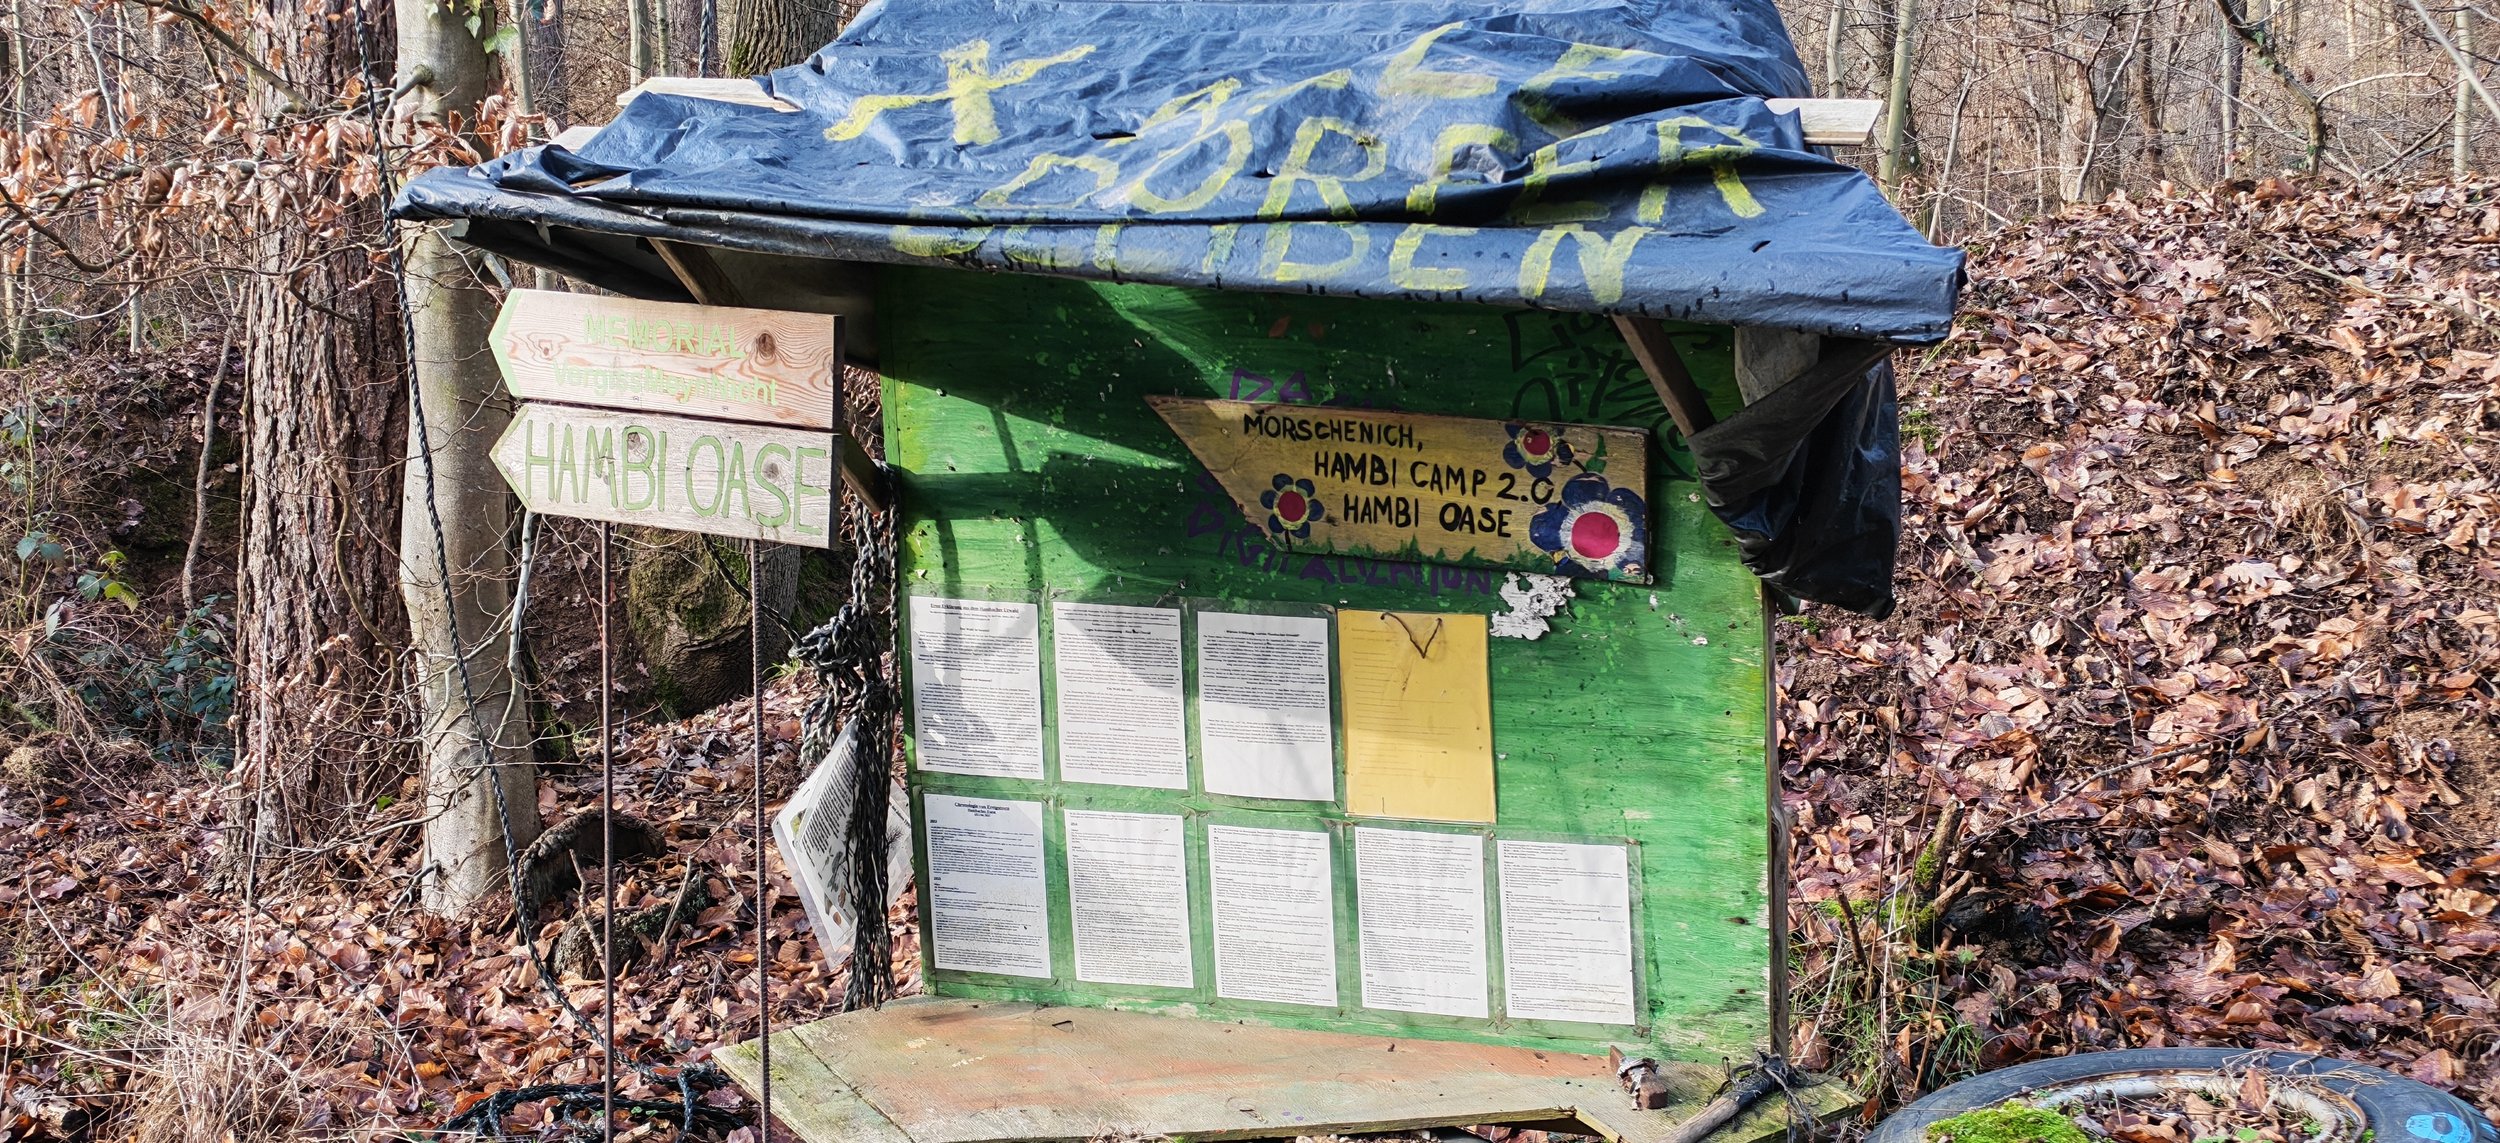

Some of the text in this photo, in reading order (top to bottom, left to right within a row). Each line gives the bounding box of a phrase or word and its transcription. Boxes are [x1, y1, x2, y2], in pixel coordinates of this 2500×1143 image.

[582, 313, 747, 359] MEMORIAL
[1243, 413, 1423, 452] MORSCHENICH,
[525, 419, 828, 537] HAMBI OASE
[1313, 450, 1397, 489] HAMBI
[1410, 460, 1487, 498] CAMP
[1342, 493, 1513, 538] HAMBI OASE
